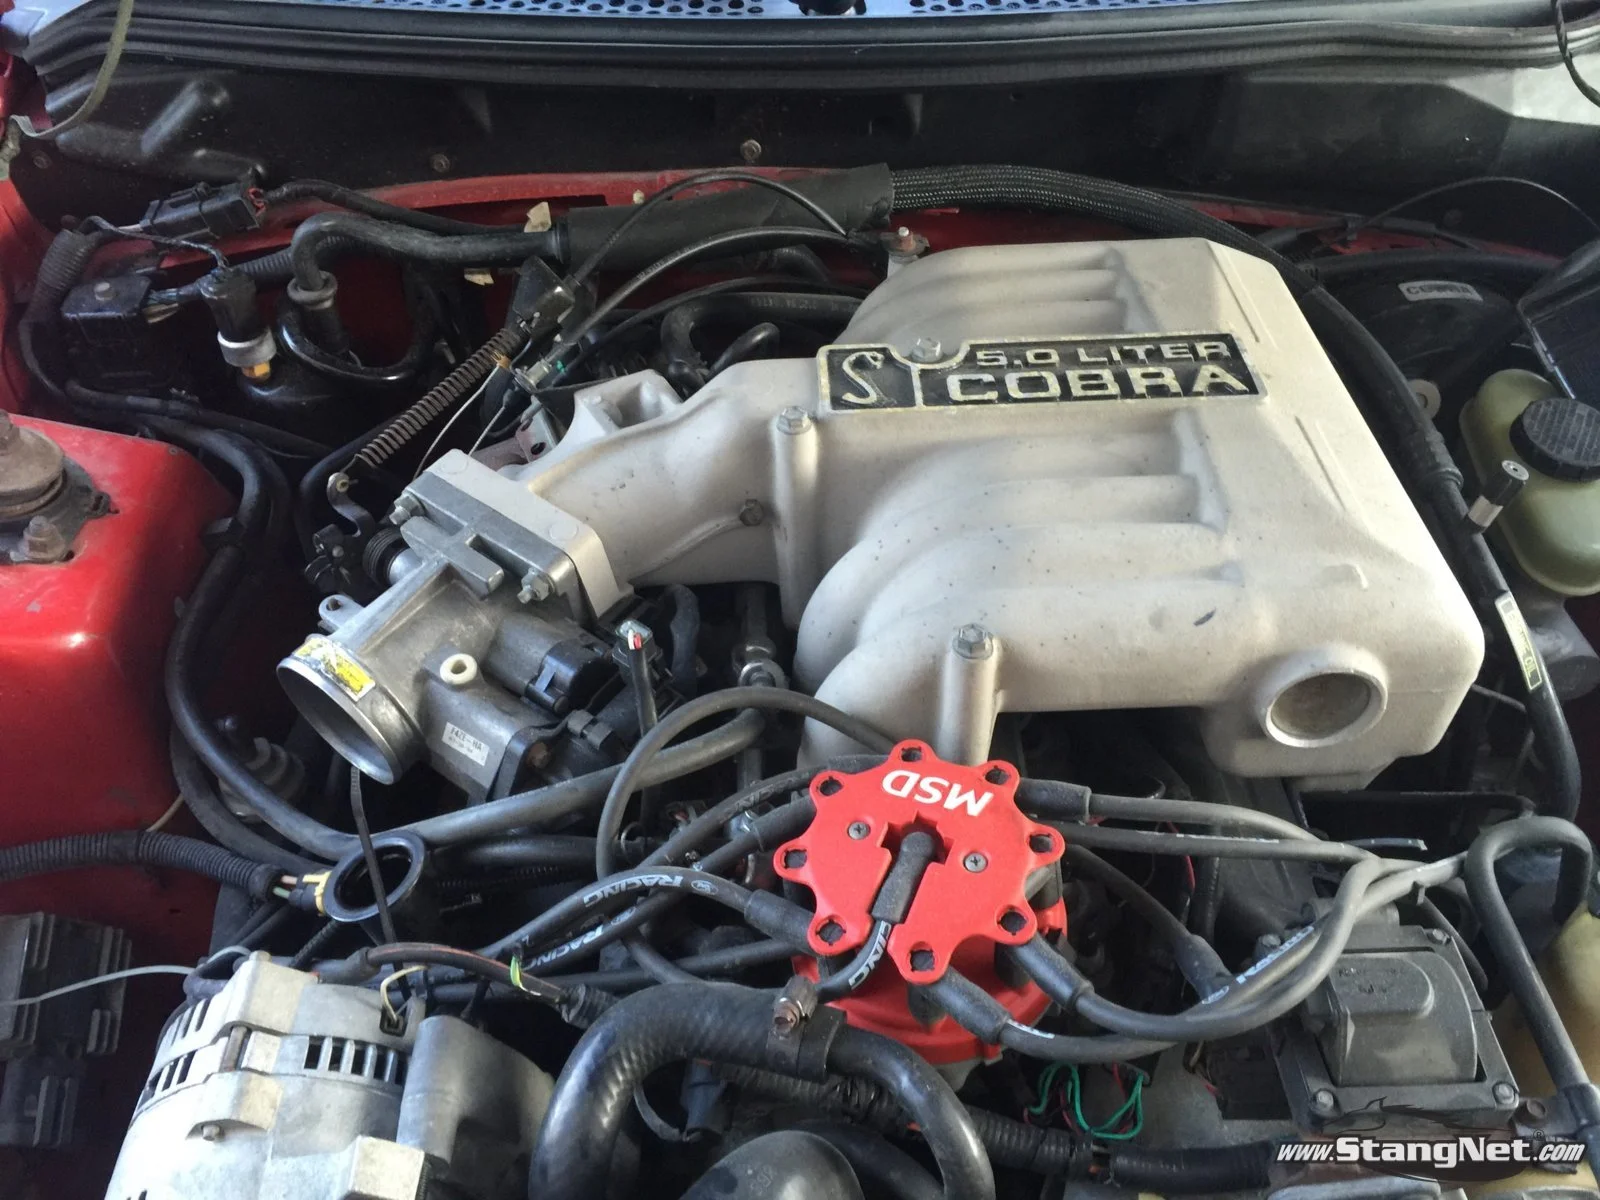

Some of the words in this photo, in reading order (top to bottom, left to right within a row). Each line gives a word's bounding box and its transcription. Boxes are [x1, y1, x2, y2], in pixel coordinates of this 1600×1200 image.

[976, 348, 1060, 369] 5.0
[1077, 341, 1232, 366] LITER
[946, 364, 1250, 402] COBRA
[882, 769, 993, 817] MSD
[583, 874, 684, 908] RACING
